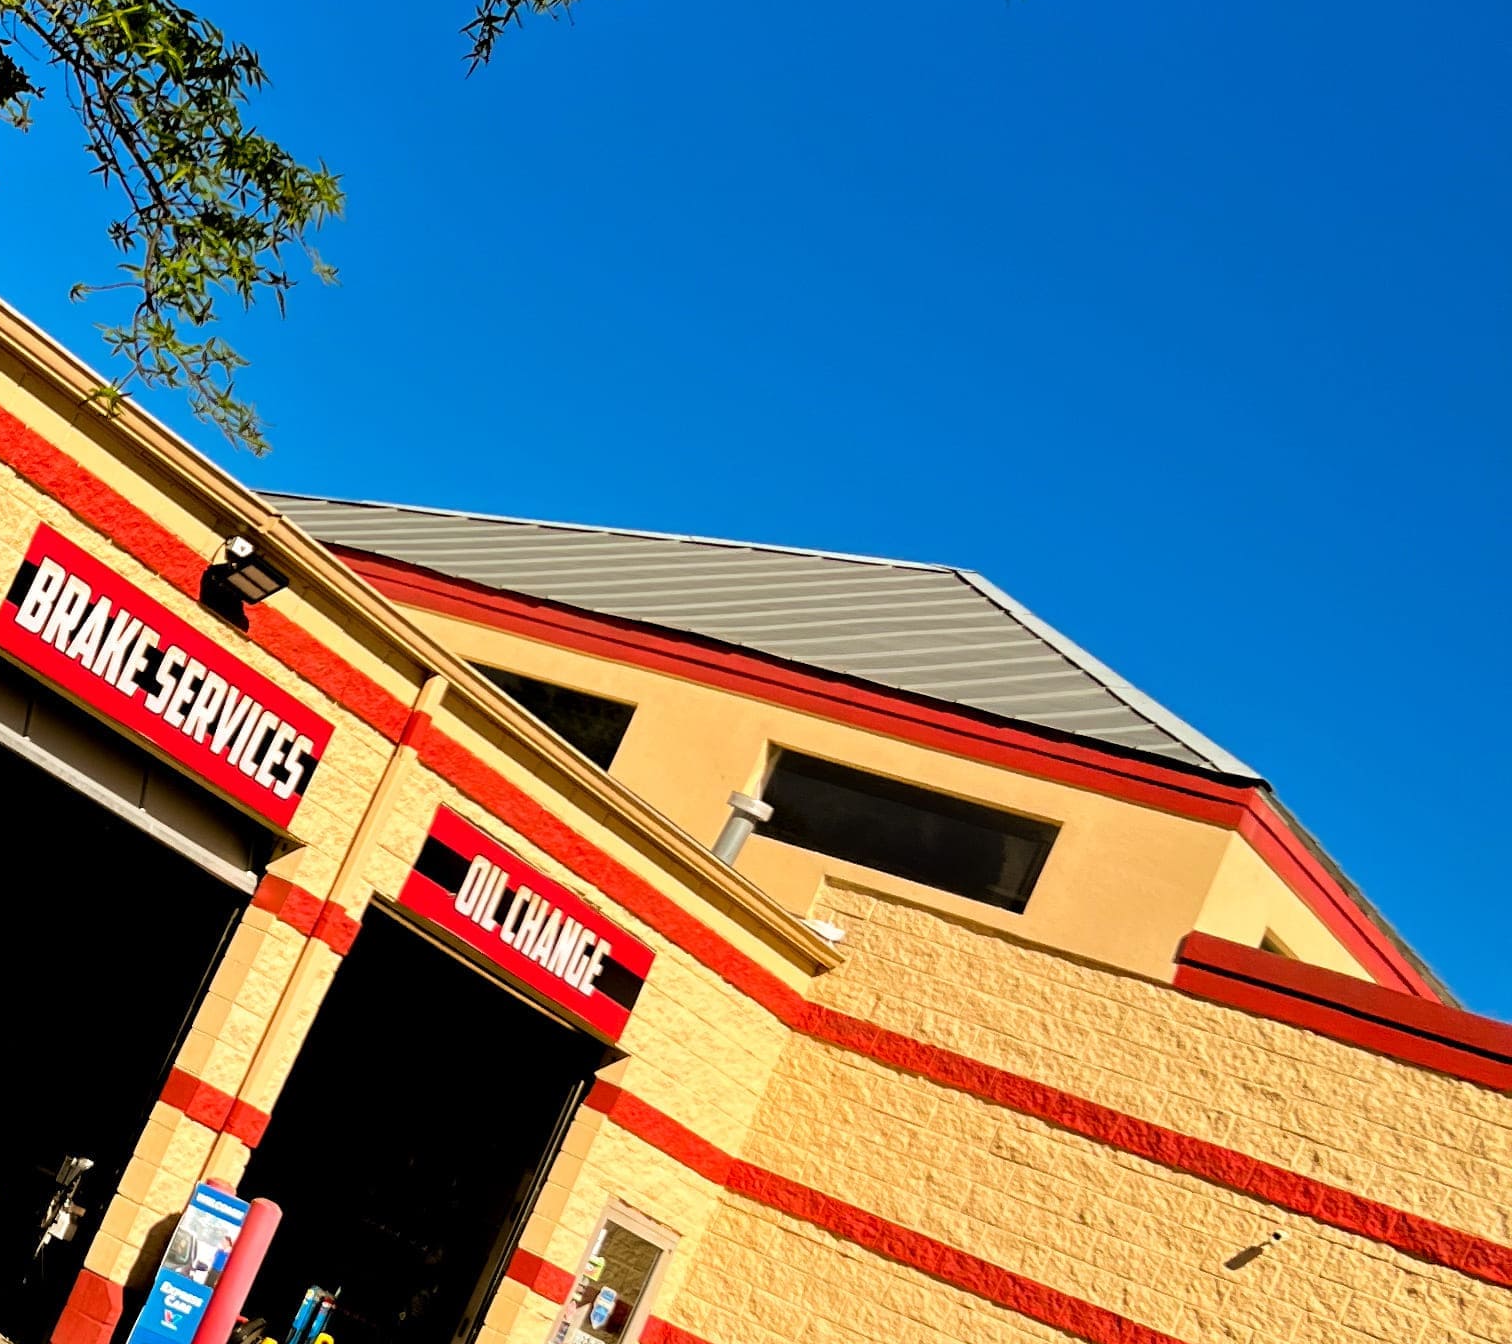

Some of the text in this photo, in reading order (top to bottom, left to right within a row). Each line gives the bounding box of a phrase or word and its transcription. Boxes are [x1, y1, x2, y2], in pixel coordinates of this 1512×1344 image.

[14, 556, 315, 800] BRAKE SERVICES
[455, 854, 612, 997] OIL CHANGE
